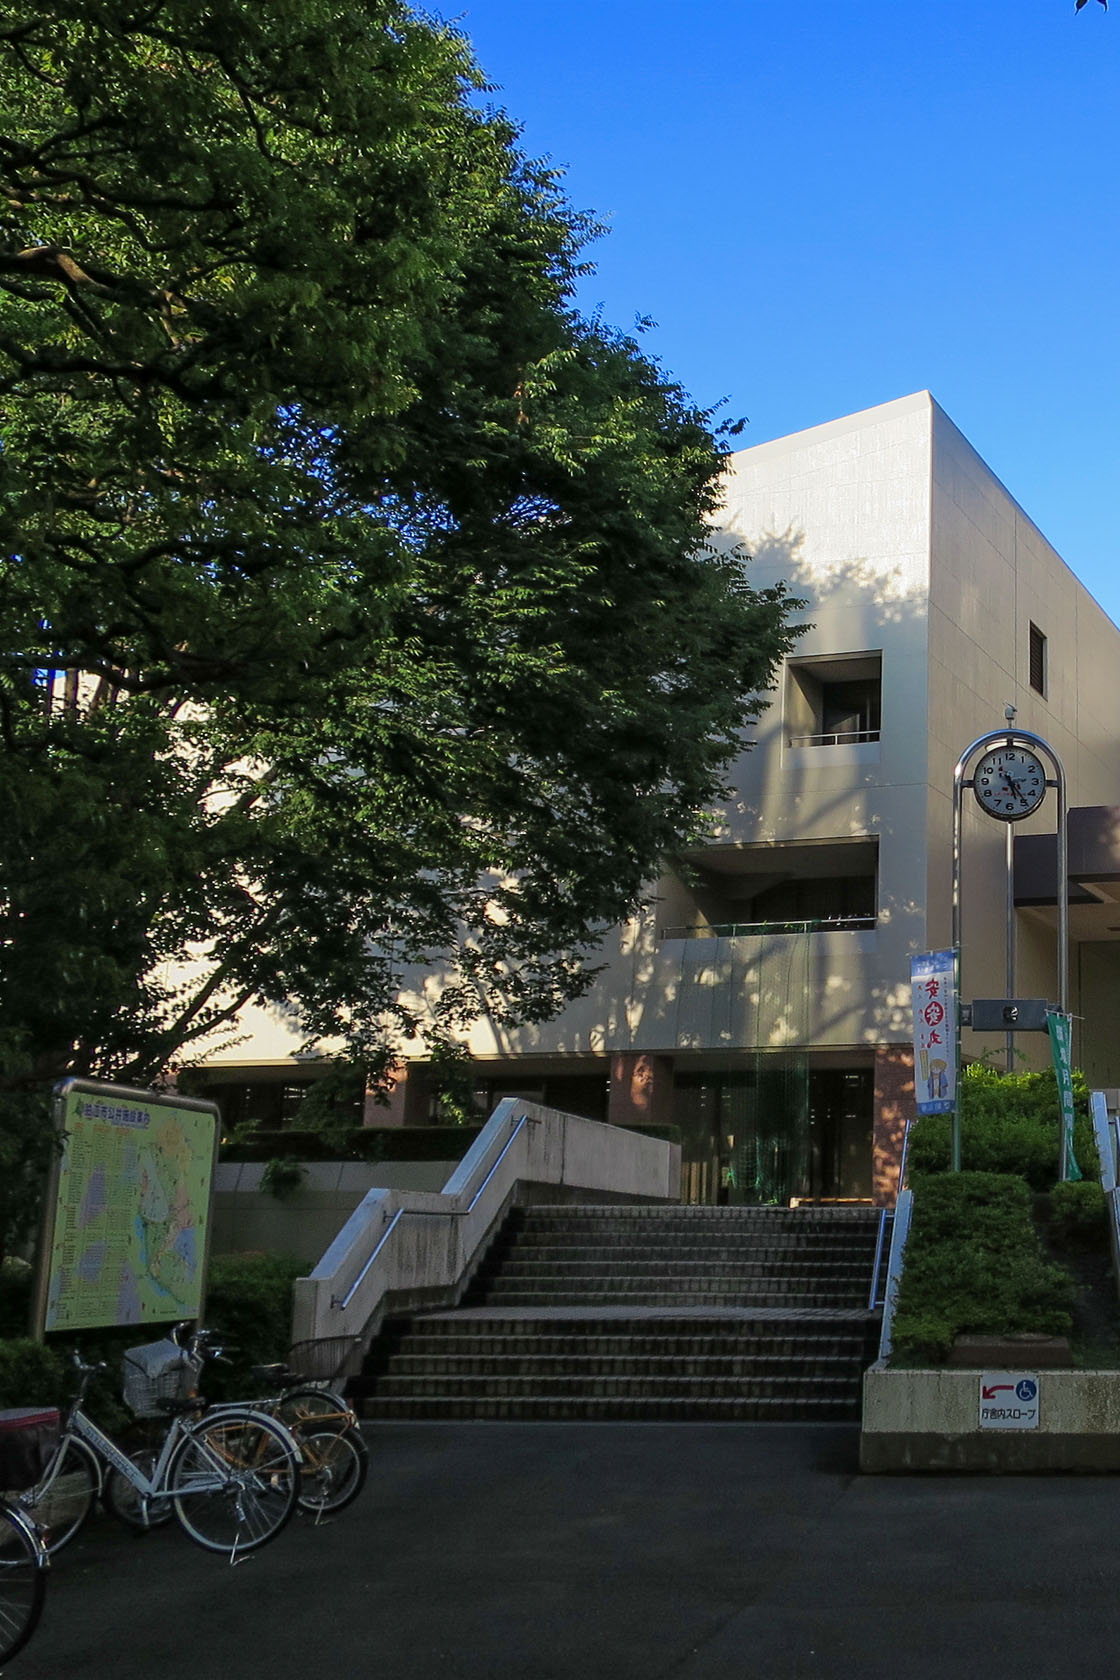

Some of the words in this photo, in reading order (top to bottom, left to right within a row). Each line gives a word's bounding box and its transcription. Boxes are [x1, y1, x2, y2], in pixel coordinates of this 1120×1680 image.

[1005, 752, 1016, 761] 12
[983, 767, 994, 775] 10
[1028, 765, 1036, 774] 2
[981, 778, 989, 786] 9
[1031, 778, 1040, 786] 3
[983, 789, 992, 797] 8
[1027, 789, 1036, 797] 4
[994, 799, 1002, 807] 7
[1005, 802, 1014, 811] 6
[981, 1408, 1037, 1420] 庁舎内スロープ
